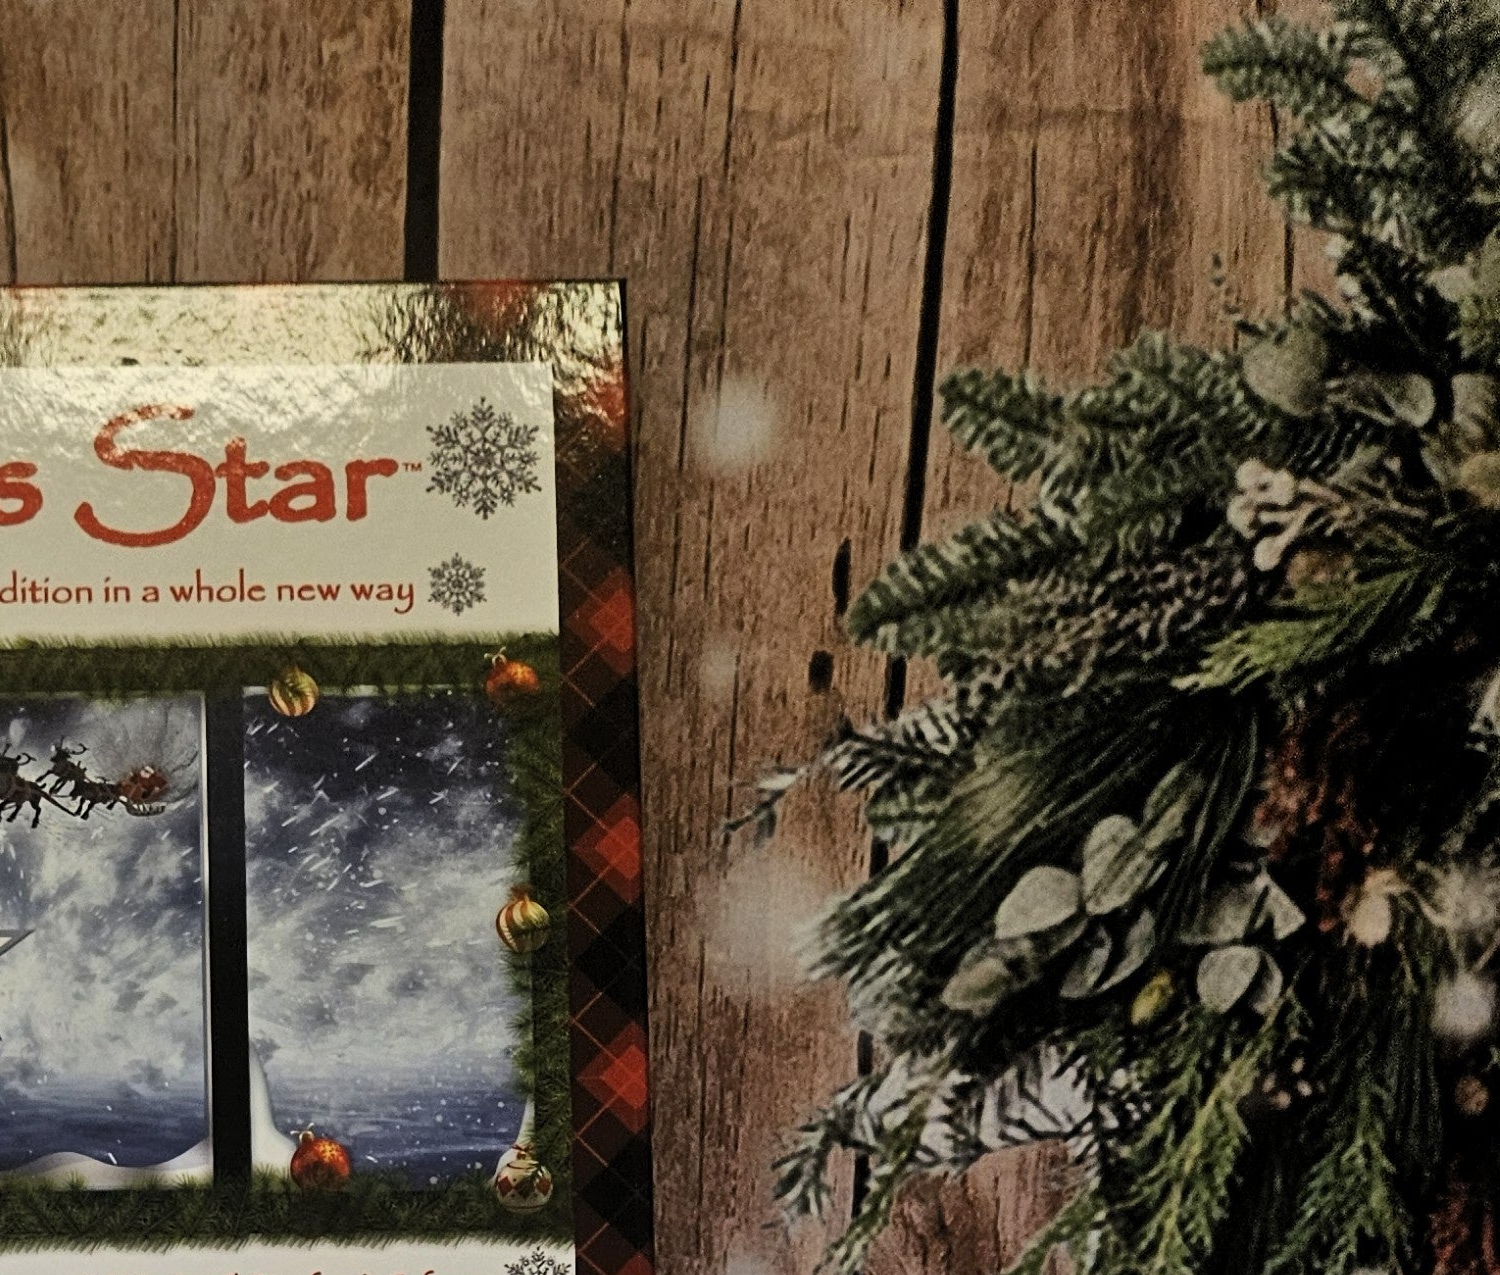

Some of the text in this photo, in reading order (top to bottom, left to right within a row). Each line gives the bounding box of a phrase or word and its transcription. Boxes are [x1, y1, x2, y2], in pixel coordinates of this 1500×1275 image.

[103, 576, 131, 604] in
[141, 585, 160, 604] a
[169, 567, 267, 604] whole
[276, 583, 342, 602] new
[349, 583, 415, 615] way
